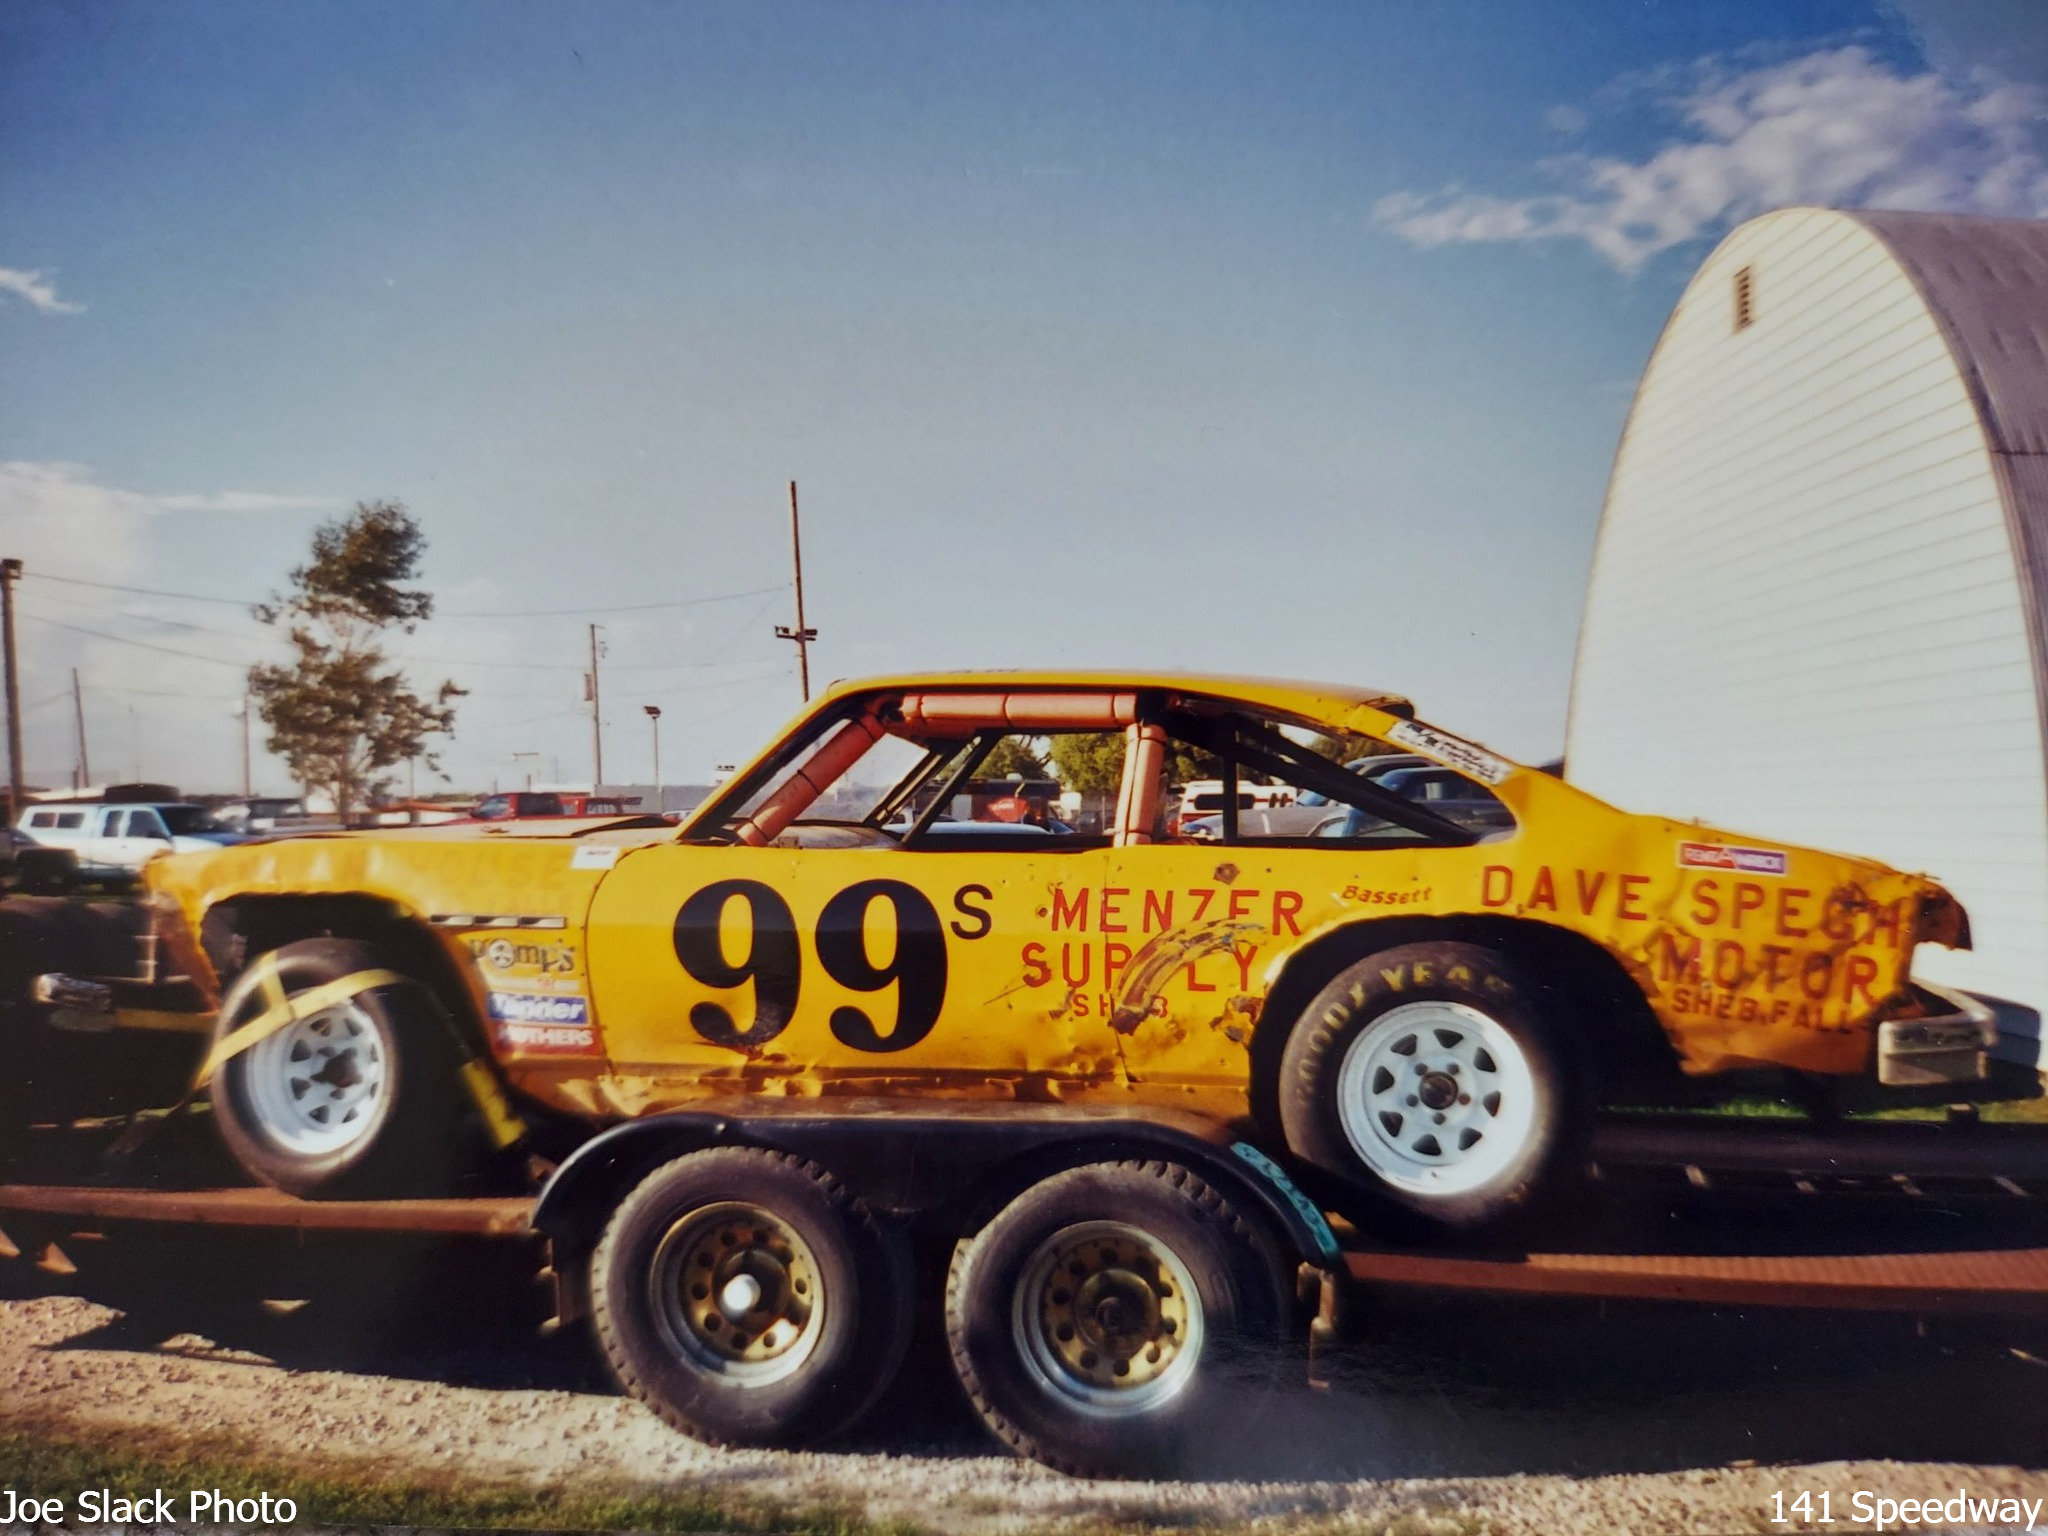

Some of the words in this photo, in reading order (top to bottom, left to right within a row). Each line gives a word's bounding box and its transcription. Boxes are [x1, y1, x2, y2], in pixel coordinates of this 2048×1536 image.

[1051, 887, 1304, 937] MENZER
[1342, 885, 1432, 904] Bassett
[1480, 865, 1651, 921] DAVE
[1021, 943, 1258, 992] SUPLY
[1659, 932, 1880, 1007] MOTOR
[1072, 993, 1168, 1018] SHB
